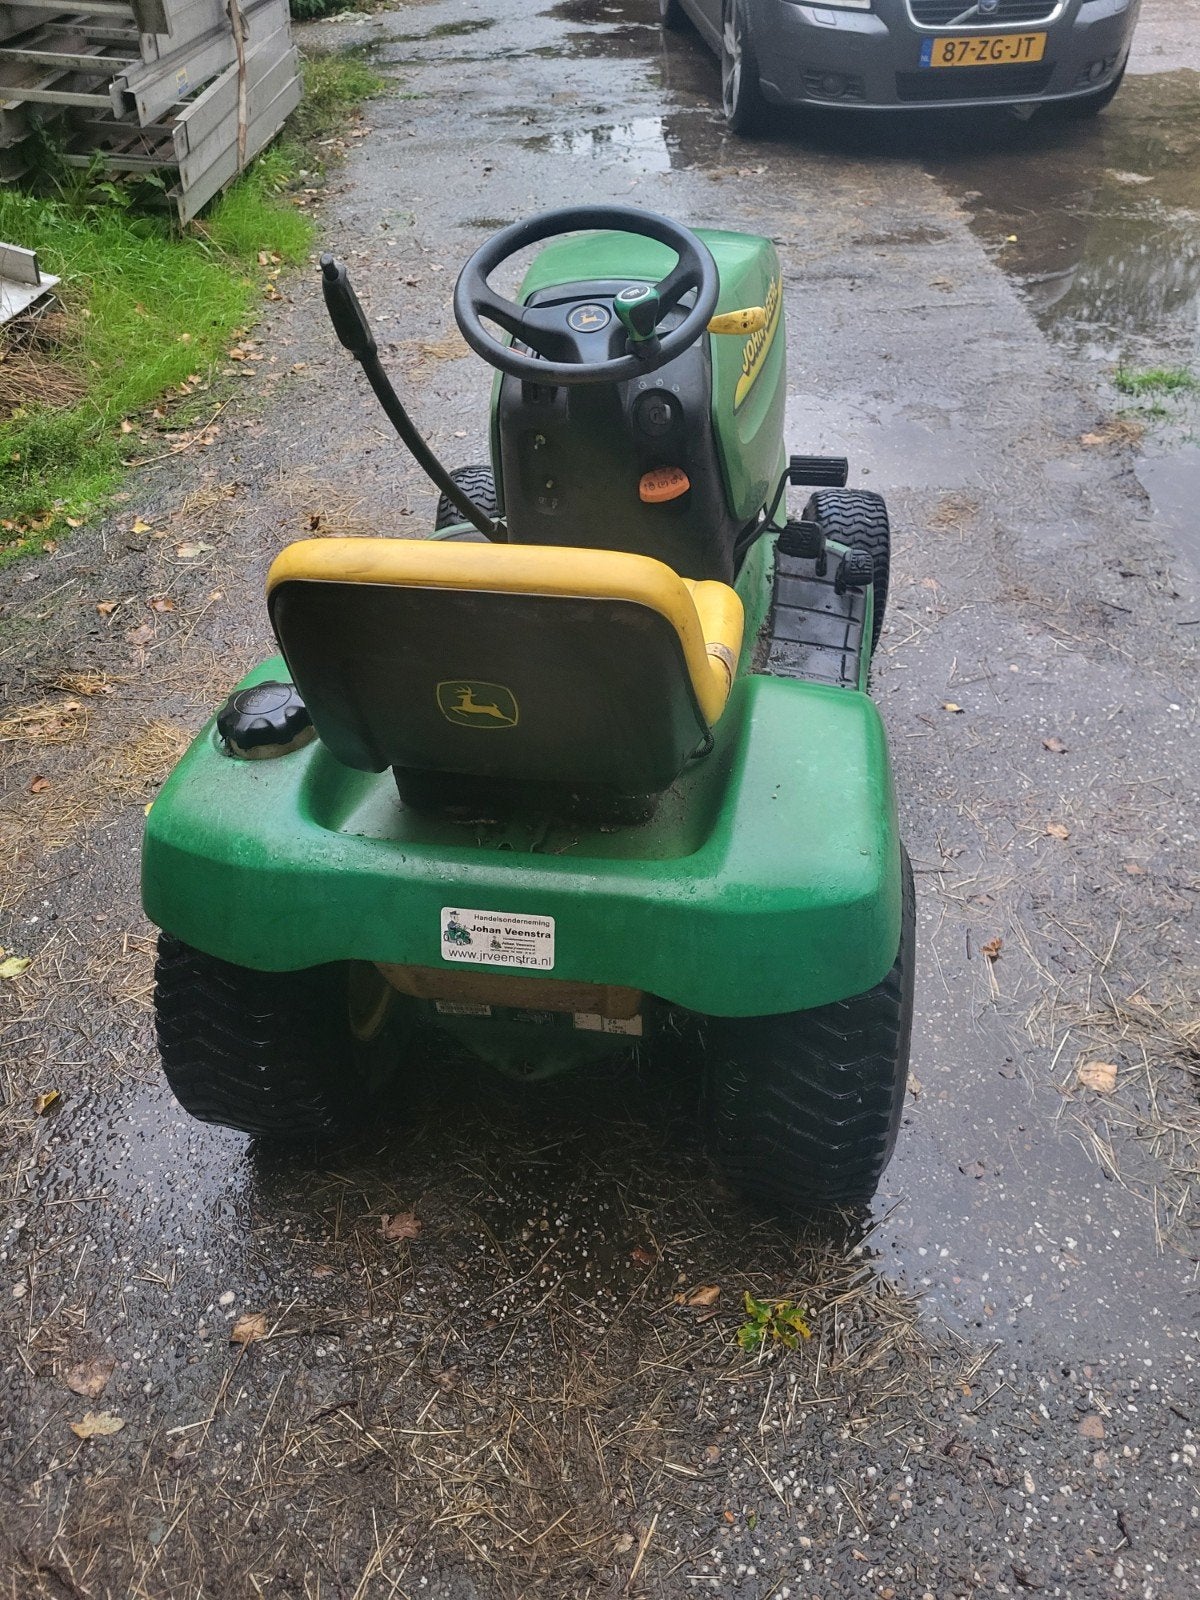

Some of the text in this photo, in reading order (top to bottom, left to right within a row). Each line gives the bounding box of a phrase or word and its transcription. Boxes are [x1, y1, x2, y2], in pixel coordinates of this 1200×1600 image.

[941, 36, 1036, 62] 87-ZG-JT
[474, 914, 550, 927] Handelsonderneming
[470, 925, 551, 939] Johan Veenstra
[448, 949, 551, 966] www.jrveenstra.nl
